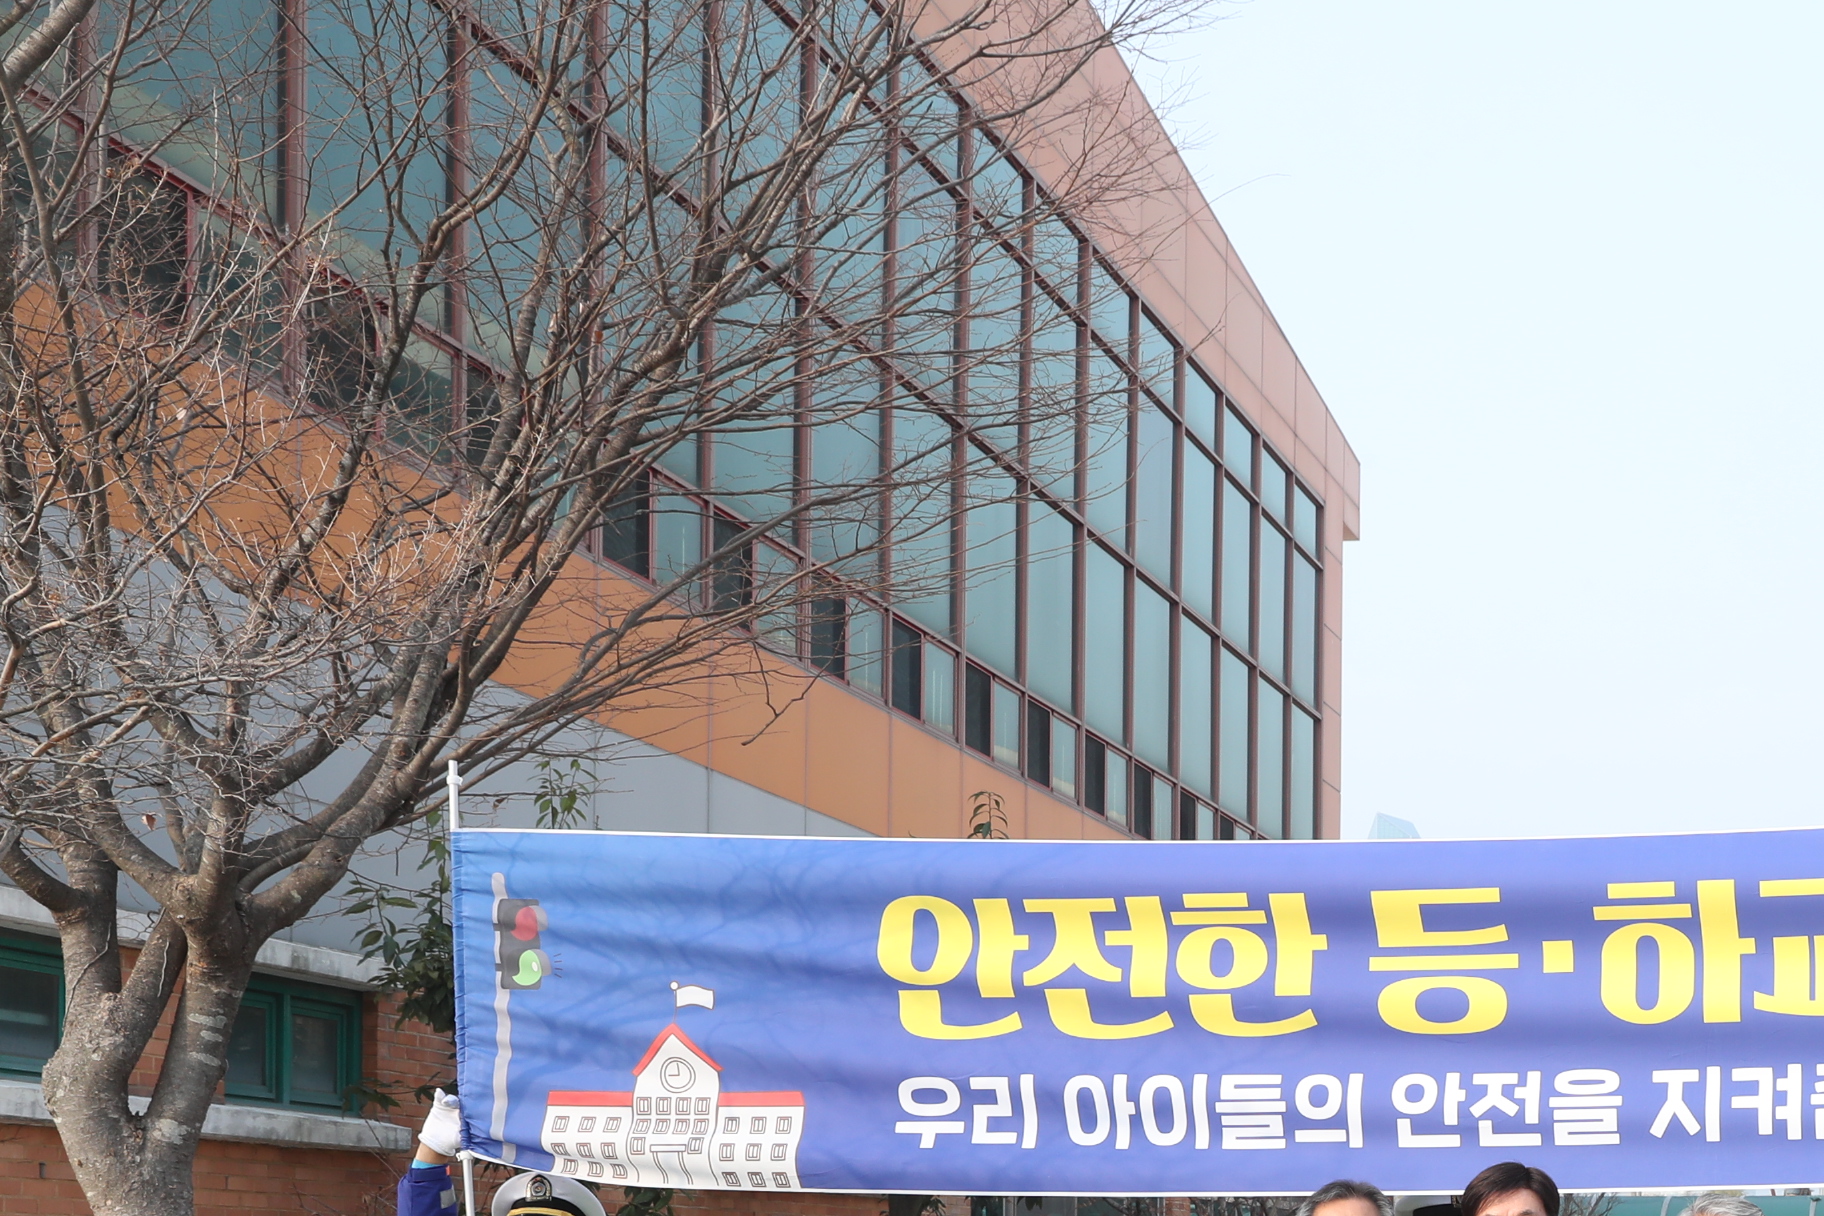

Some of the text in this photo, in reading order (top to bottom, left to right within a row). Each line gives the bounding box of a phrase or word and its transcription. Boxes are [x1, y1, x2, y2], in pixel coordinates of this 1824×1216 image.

[876, 892, 1328, 1041] 안전한
[895, 1075, 1040, 1149] 우리
[1064, 1073, 1364, 1150] 아이들의
[1390, 1068, 1624, 1149] 안전을
